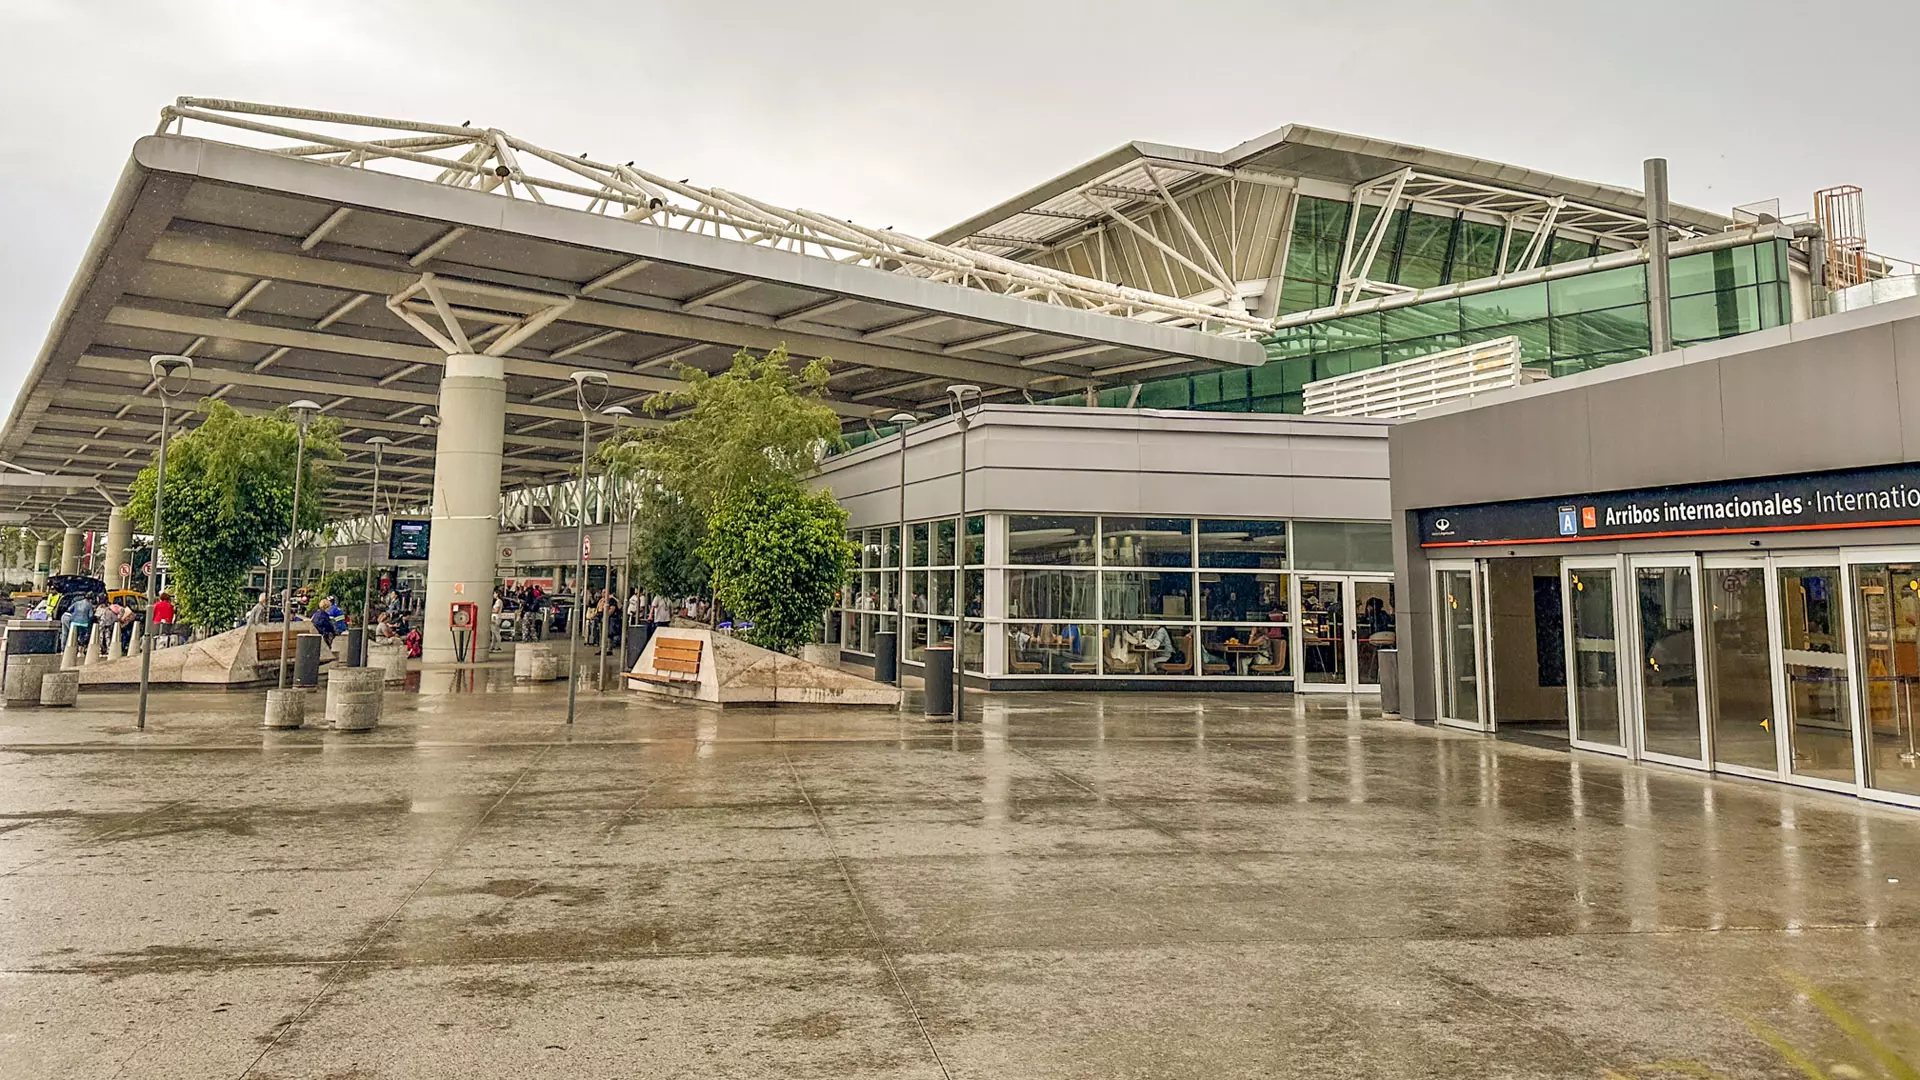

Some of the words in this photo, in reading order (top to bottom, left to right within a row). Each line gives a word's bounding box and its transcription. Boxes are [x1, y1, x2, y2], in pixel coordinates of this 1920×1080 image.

[1605, 504, 1660, 526] Arribos
[1664, 493, 1803, 521] internacionales
[1816, 484, 1920, 513] Internatio
[1564, 515, 1573, 531] A
